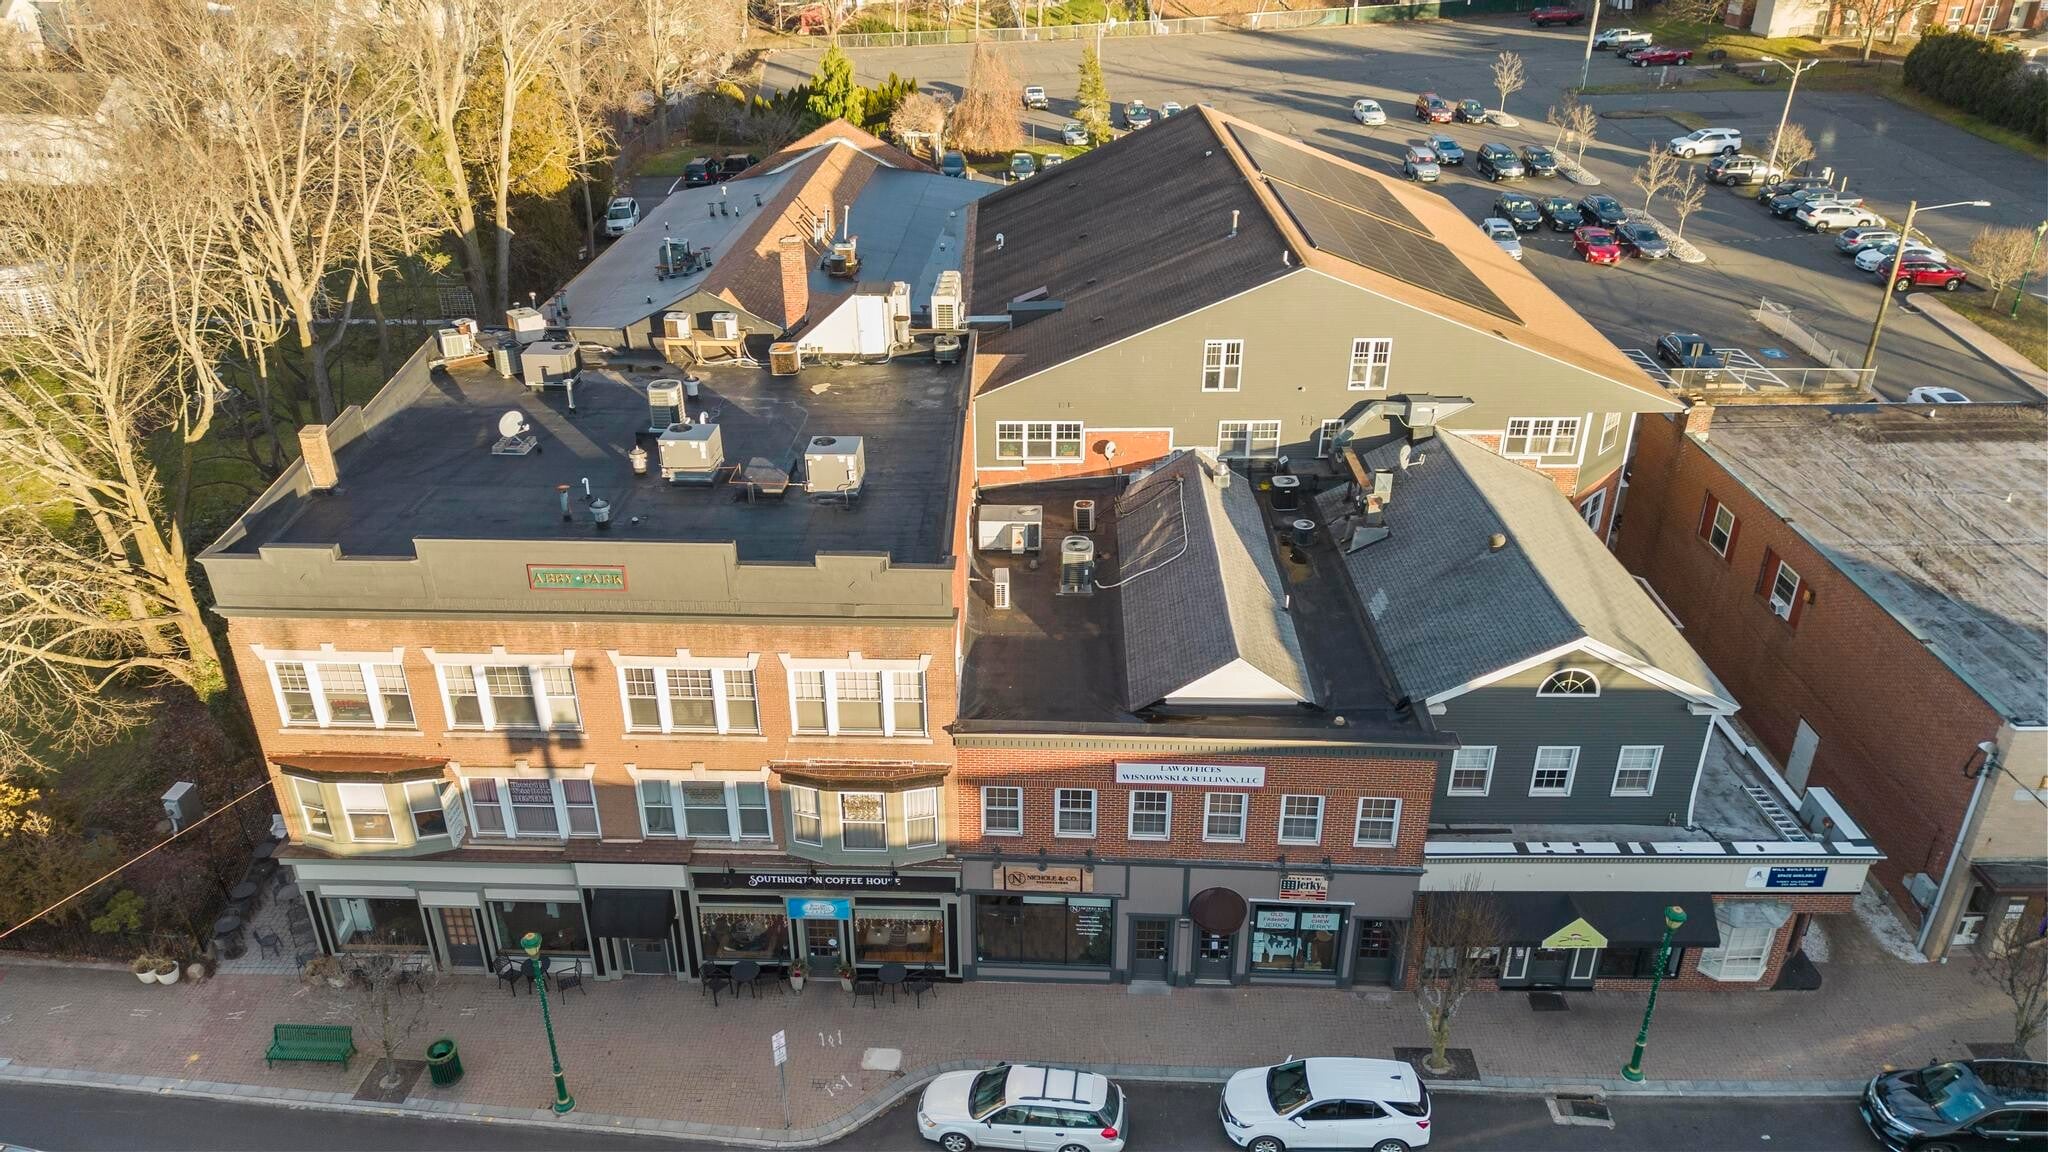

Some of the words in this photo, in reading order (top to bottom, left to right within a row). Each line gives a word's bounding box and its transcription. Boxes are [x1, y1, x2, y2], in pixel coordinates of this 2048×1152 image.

[582, 574, 623, 585] PARK
[1122, 774, 1180, 782] WISNIOWSKI
[825, 876, 864, 885] COFFEE
[1297, 880, 1322, 891] Jerky
